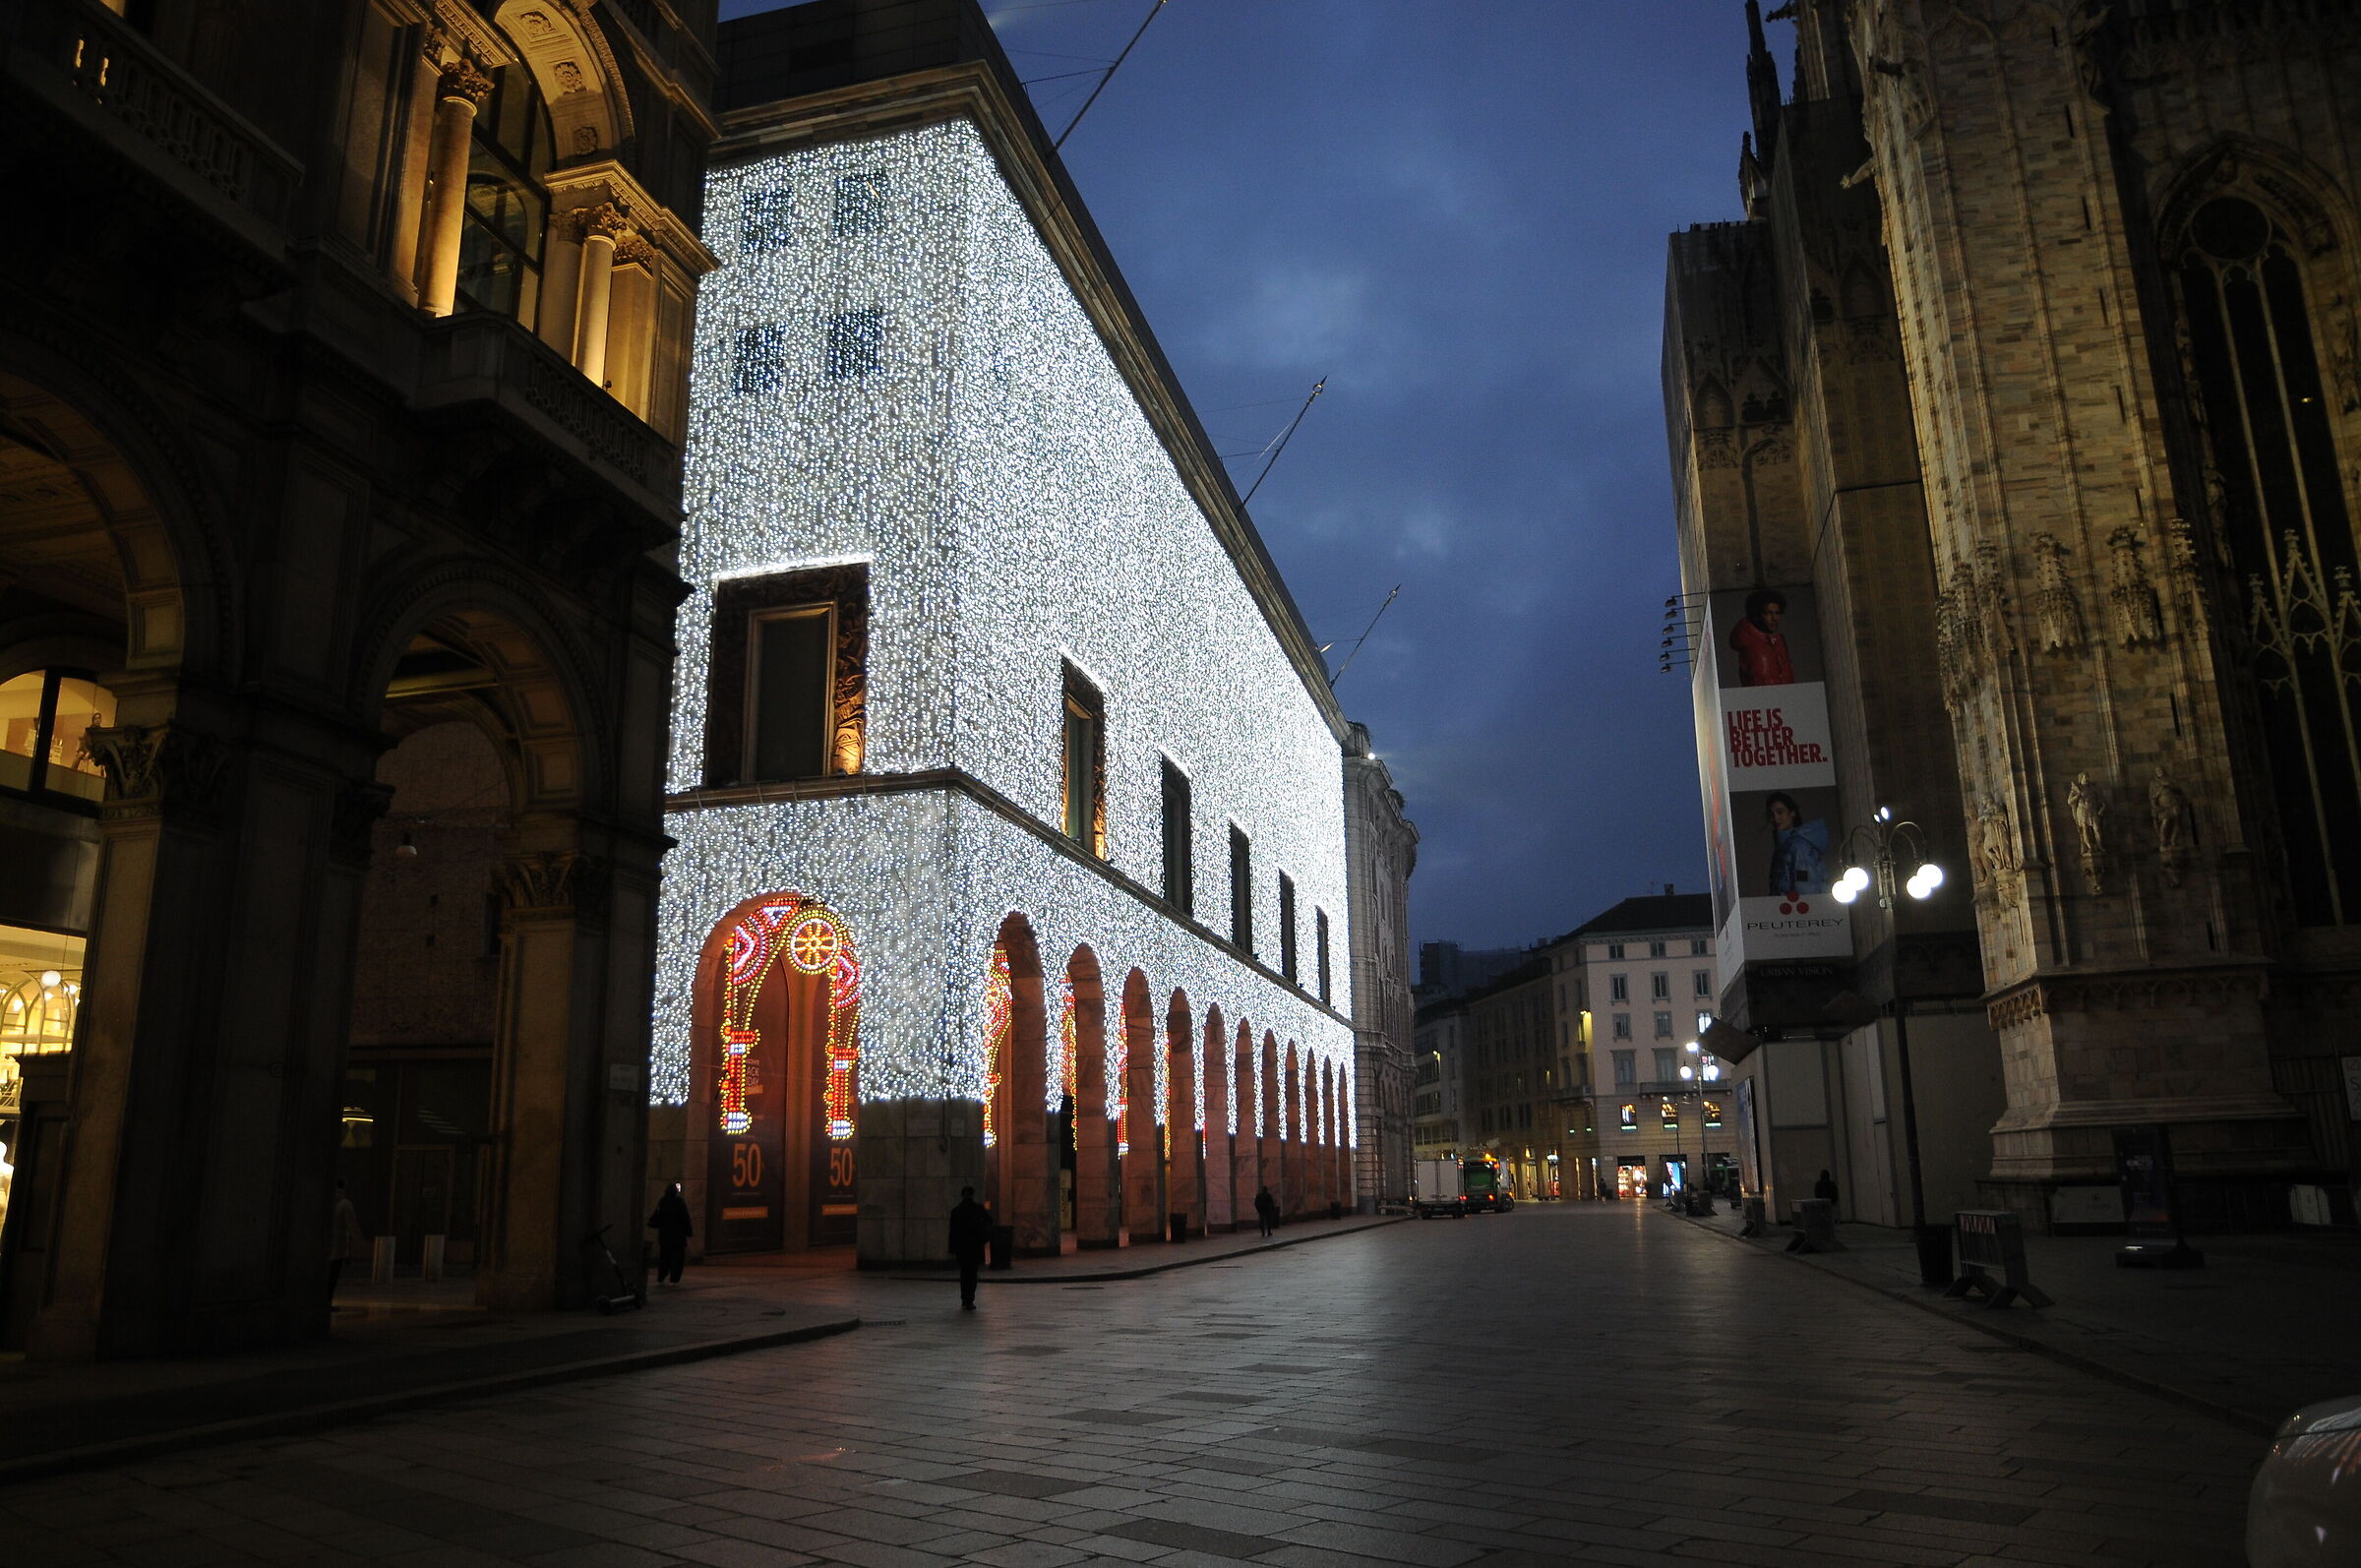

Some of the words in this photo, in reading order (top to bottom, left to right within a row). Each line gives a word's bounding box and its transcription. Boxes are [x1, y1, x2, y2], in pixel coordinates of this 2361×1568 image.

[1727, 709, 1762, 731] LIFE
[1766, 708, 1783, 729] IS
[1730, 727, 1794, 749] BETTER
[1731, 744, 1827, 767] TOGETHER.
[1747, 918, 1844, 930] PEUTEREY
[1759, 967, 1795, 977] URBAN
[1797, 965, 1834, 976] VISION
[732, 1142, 762, 1187] 50
